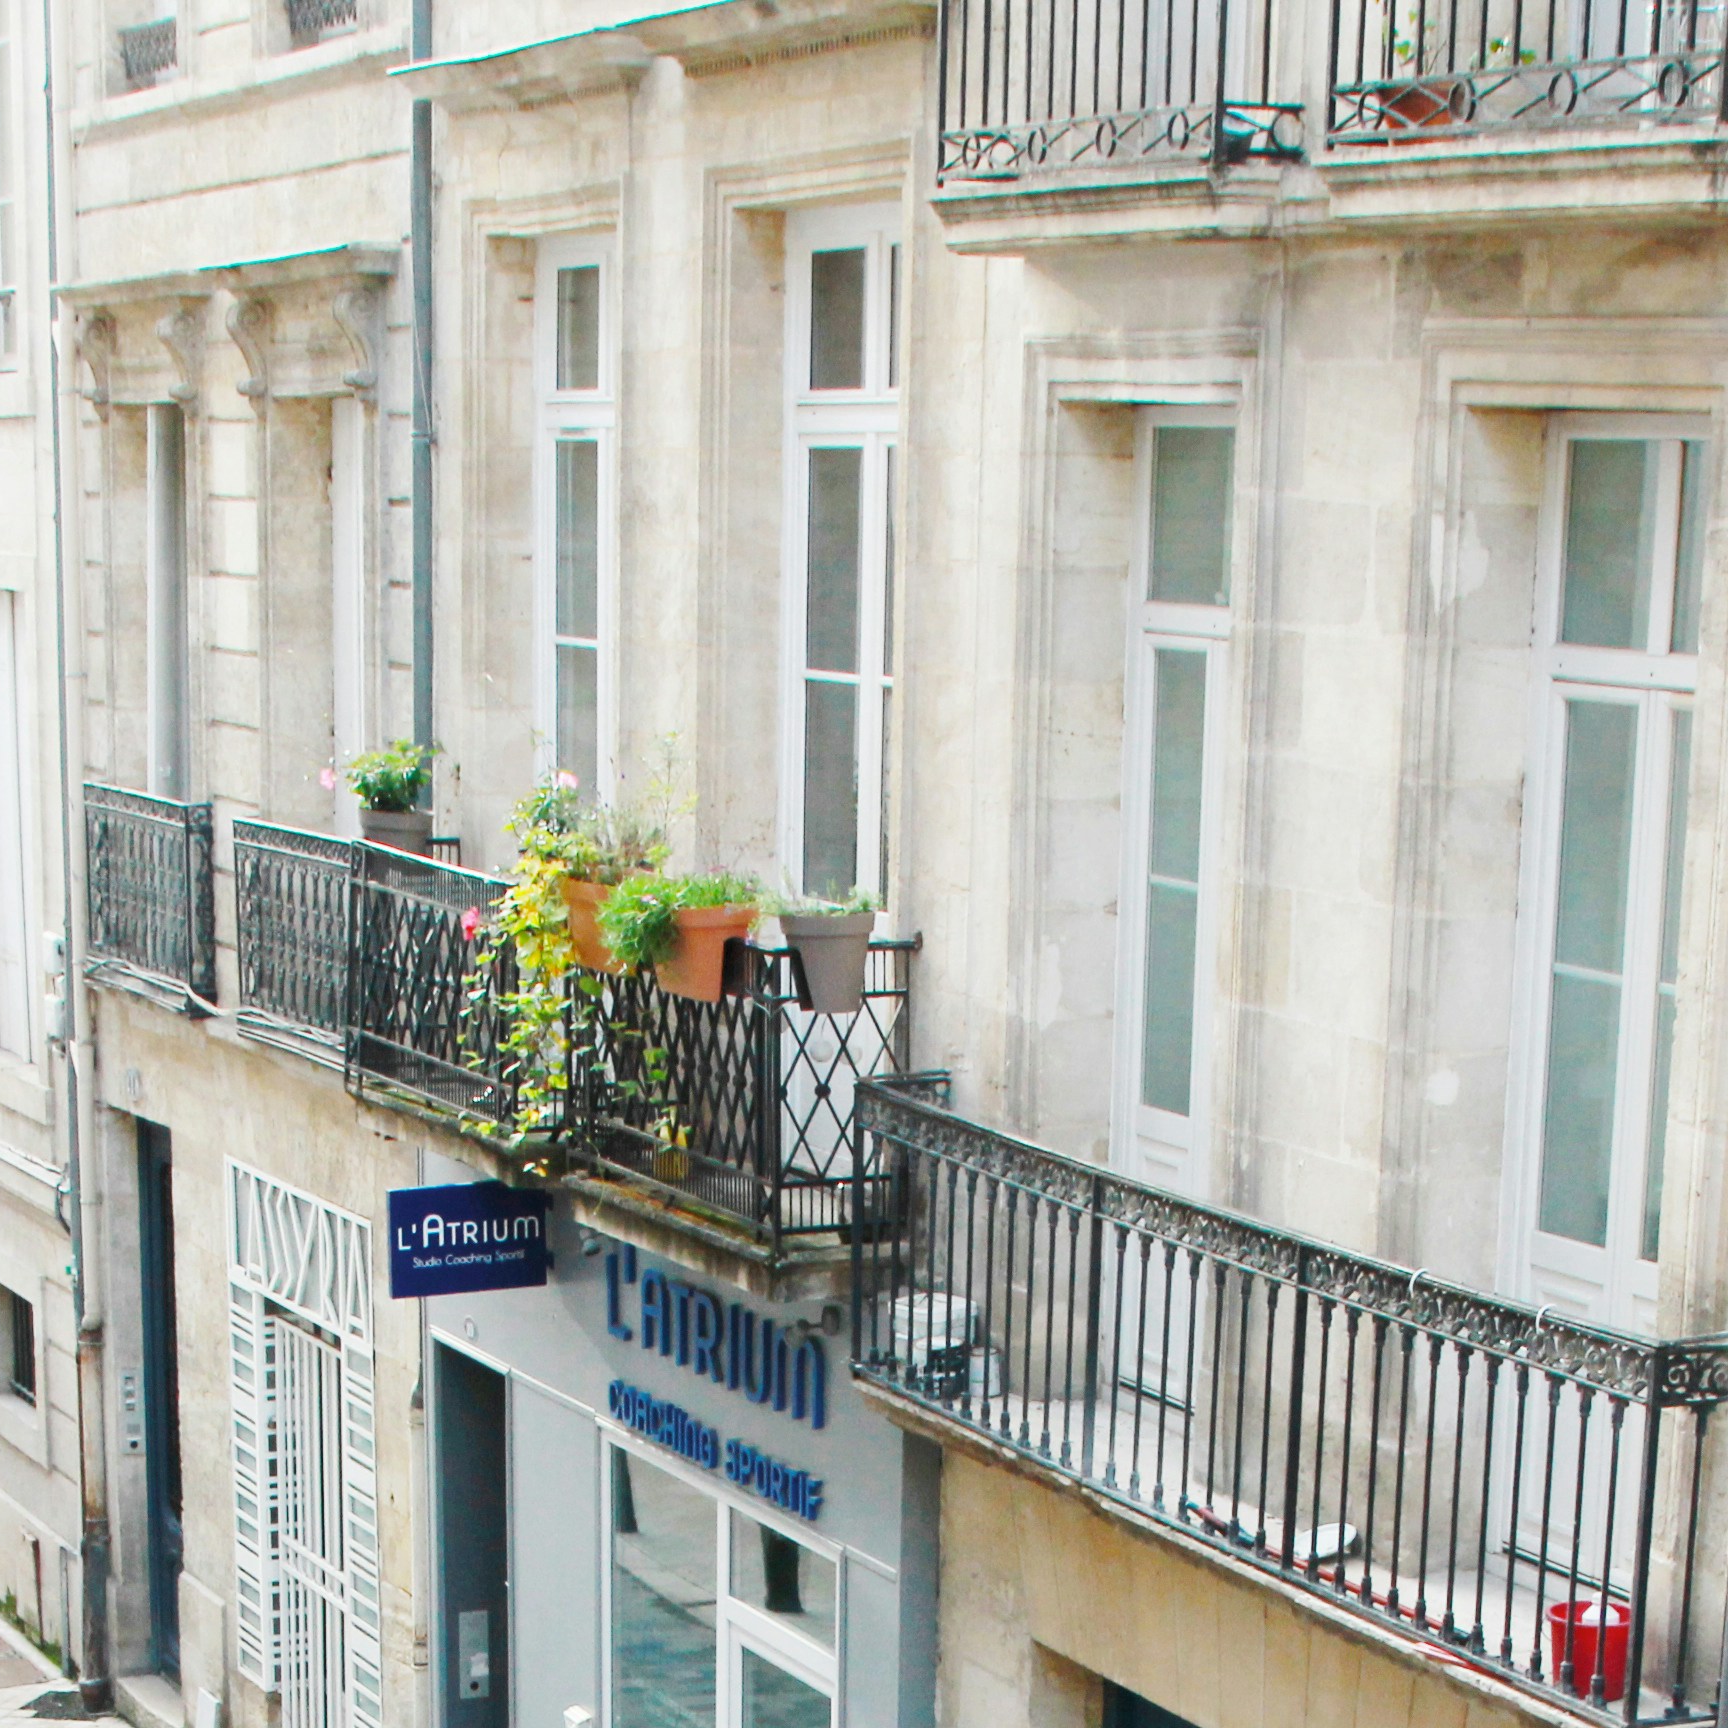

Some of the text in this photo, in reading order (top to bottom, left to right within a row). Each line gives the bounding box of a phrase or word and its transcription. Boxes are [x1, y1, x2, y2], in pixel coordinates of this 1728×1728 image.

[412, 1257, 443, 1268] Studio
[445, 1252, 492, 1265] Coaching
[606, 1243, 826, 1430] L'ATRIUM
[608, 1380, 825, 1521] COACHING SPORTIF
